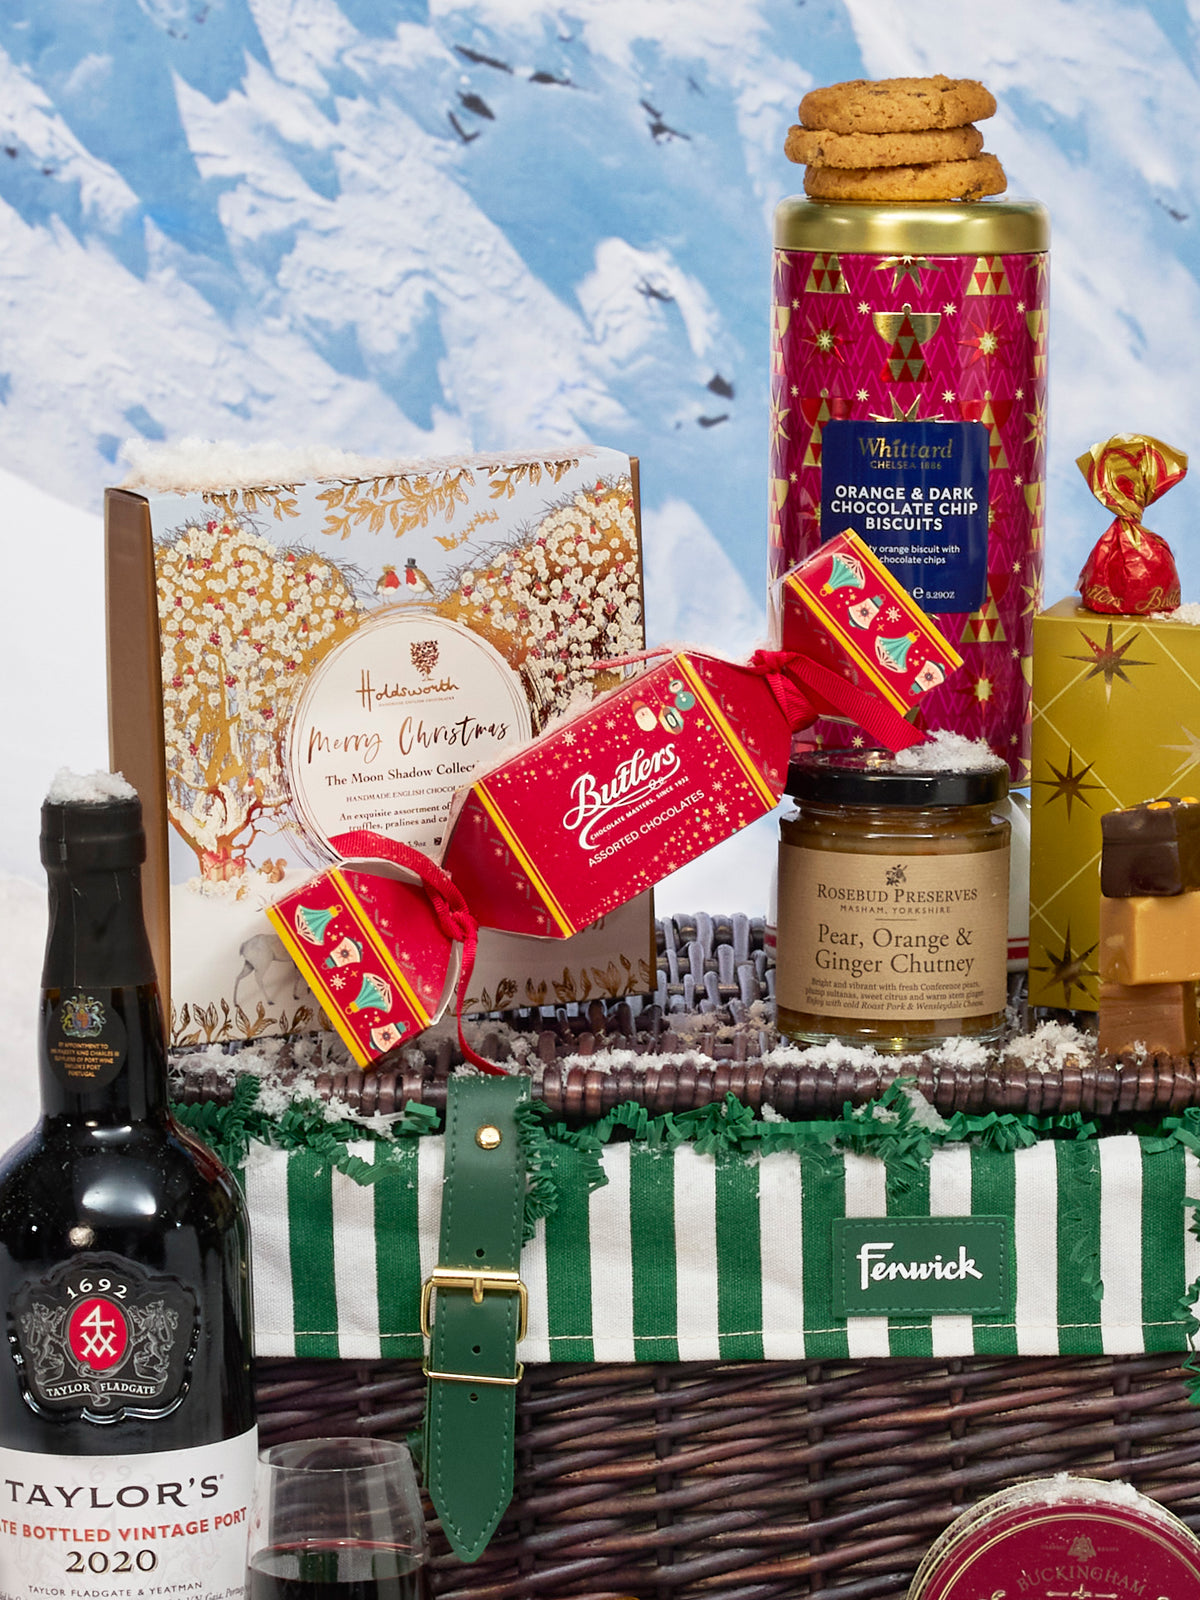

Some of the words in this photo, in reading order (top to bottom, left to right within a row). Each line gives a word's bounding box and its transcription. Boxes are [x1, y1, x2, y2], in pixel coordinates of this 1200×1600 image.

[858, 437, 953, 459] Whittard
[870, 460, 916, 470] CHELSEA
[921, 461, 942, 470] 1886
[835, 485, 905, 500] ORANGE
[911, 487, 923, 500] &
[929, 487, 974, 500] DARK
[830, 500, 934, 515] CHOCOLATE
[939, 502, 978, 515] CHIP
[865, 517, 943, 531] BISCUITS
[879, 546, 910, 555] orange
[911, 545, 940, 554] biscuit
[941, 545, 960, 553] with
[879, 555, 922, 564] chocolate
[923, 556, 946, 565] chips
[356, 669, 460, 712] Holdsworth
[308, 726, 382, 764] Merry
[399, 716, 510, 755] Christmas
[325, 775, 348, 786] The
[351, 772, 384, 784] Moon
[387, 766, 433, 781] Shadow
[346, 792, 391, 802] HANDMADE
[393, 789, 425, 798] ENGLISH
[563, 743, 681, 830] Butlers
[340, 813, 352, 821] An
[354, 810, 392, 822] exquisite
[394, 805, 440, 815] assortment
[442, 801, 452, 810] of
[590, 815, 626, 840] CHOCOLATE
[656, 785, 674, 799] SINCE
[385, 818, 419, 832] pralines
[421, 815, 437, 825] and
[588, 830, 640, 868] ASSORTED
[640, 789, 705, 835] CHOCOLATES
[817, 883, 889, 902] ROSEBUD
[894, 888, 978, 903] PRESERVES
[840, 905, 888, 915] MASHAM,
[892, 906, 950, 915] YORKSHIRE
[818, 924, 864, 948] Pear,
[873, 927, 949, 954] Orange
[956, 927, 974, 946] &
[815, 949, 883, 978] Ginger
[890, 953, 975, 977] Chutney
[833, 981, 847, 989] and
[849, 982, 877, 990] vibrant
[878, 983, 896, 991] with
[899, 983, 919, 991] fresh
[920, 982, 961, 991] Conference
[885, 992, 907, 1000] citrus
[825, 999, 841, 1007] with
[843, 1001, 859, 1009] cold
[861, 1002, 884, 1010] Roast
[886, 1002, 905, 1010] Pork
[856, 1242, 983, 1290] Fenwick
[66, 1278, 128, 1299] 1692
[46, 1383, 91, 1397] TAYLOR
[100, 1383, 156, 1395] FLADGATE
[5, 1474, 220, 1508] TAYLOR'S
[22, 1524, 111, 1542] BOTTLED
[118, 1518, 210, 1542] VINTAGE
[214, 1506, 247, 1531] PORT
[65, 1549, 158, 1574] 2020
[28, 1585, 66, 1597] TAYLOR
[71, 1588, 132, 1598] FLADGATE
[137, 1588, 145, 1596] &
[149, 1581, 203, 1595] YEATMAN
[1016, 1564, 1147, 1597] BUCKINGHAM
